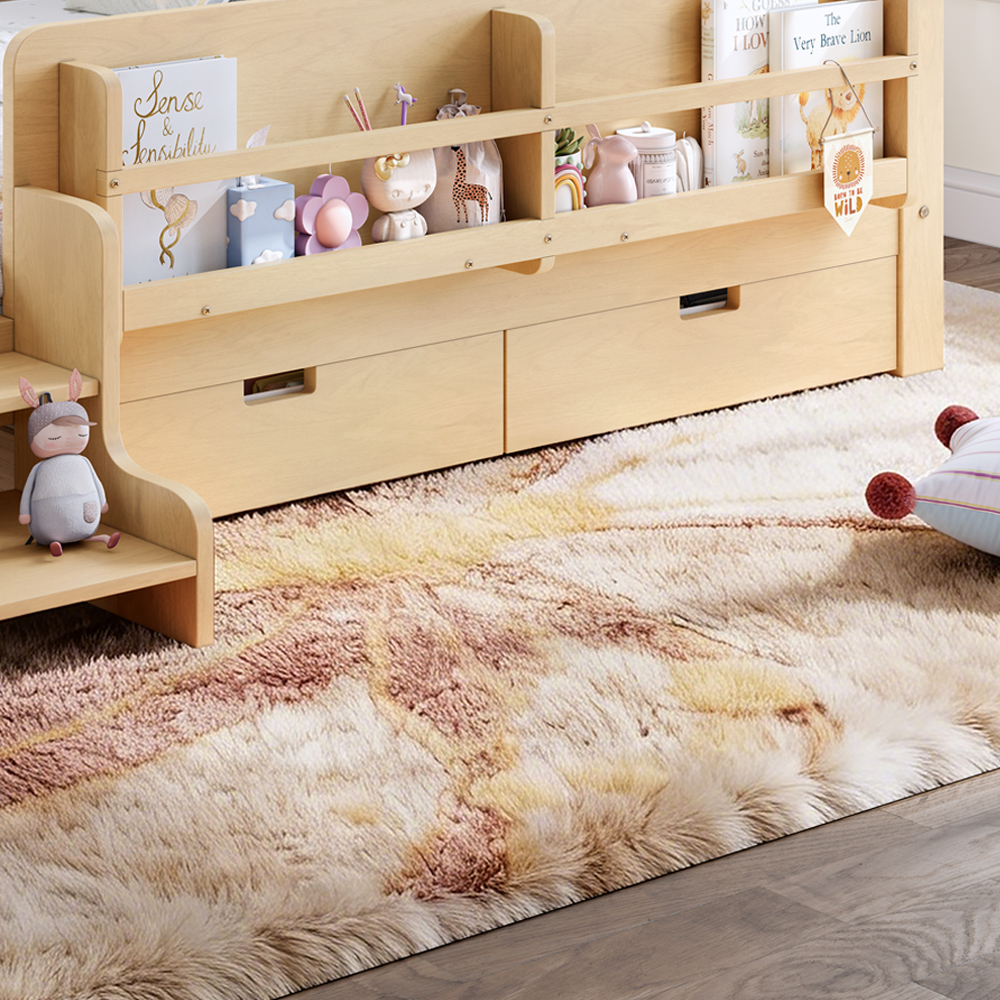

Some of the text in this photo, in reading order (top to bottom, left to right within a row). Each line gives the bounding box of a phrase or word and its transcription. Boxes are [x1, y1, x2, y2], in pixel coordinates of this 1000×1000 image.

[736, 14, 767, 32] HOW
[825, 12, 841, 26] The
[743, 32, 769, 51] LOV
[793, 28, 872, 54] Very Brave Lion
[133, 69, 204, 118] Sense
[162, 116, 174, 137] &
[848, 189, 855, 197] TO
[856, 186, 863, 195] BE
